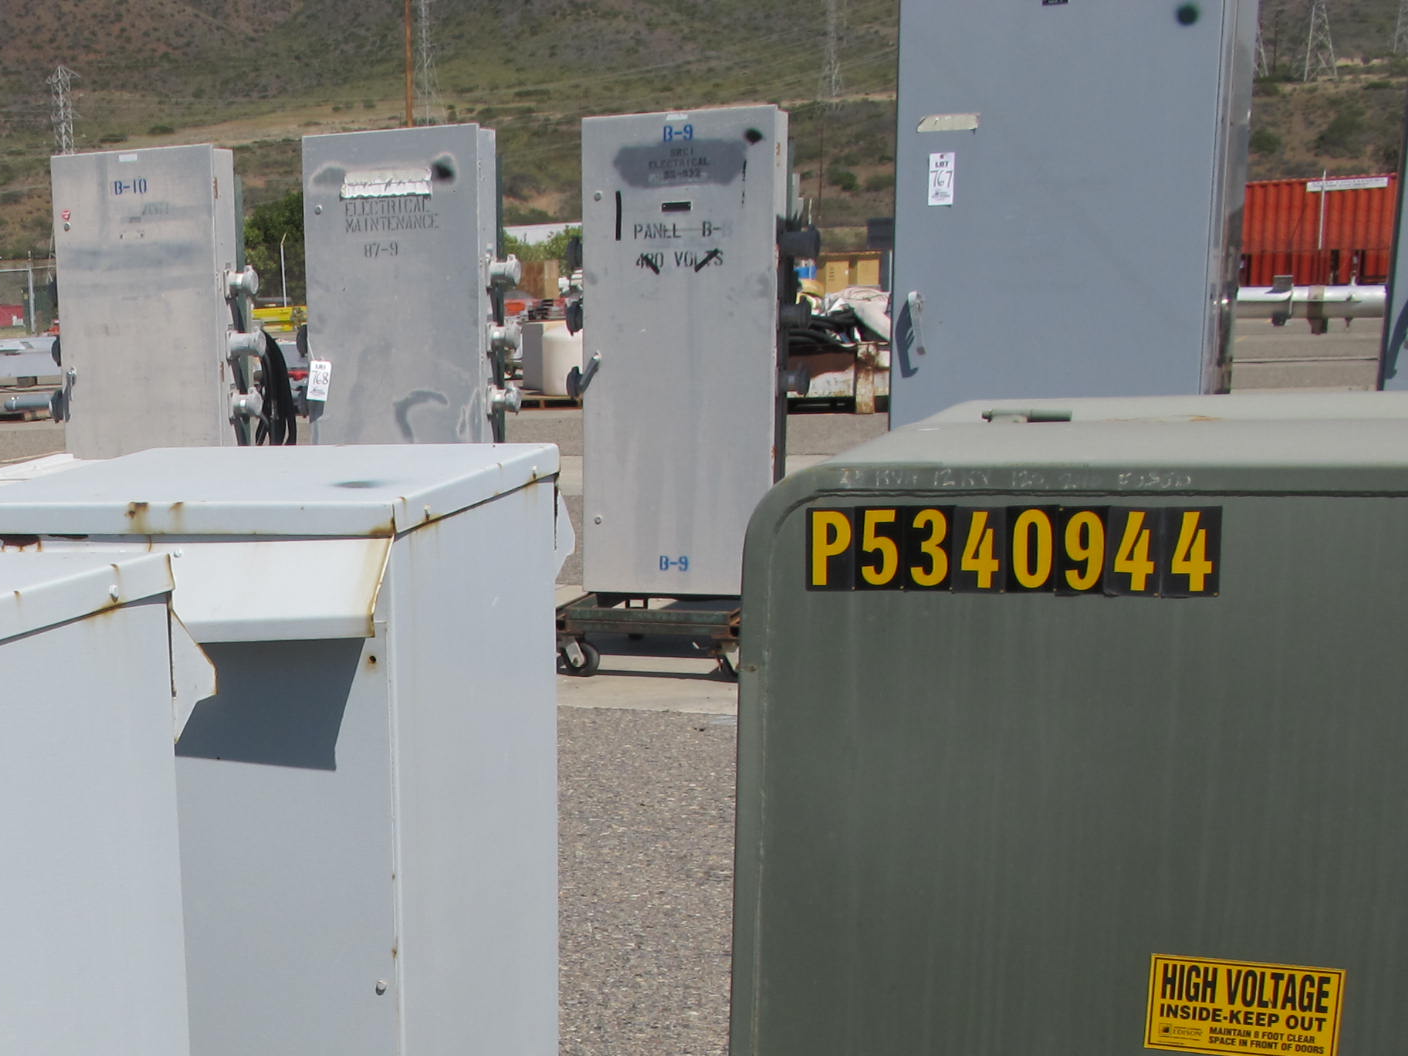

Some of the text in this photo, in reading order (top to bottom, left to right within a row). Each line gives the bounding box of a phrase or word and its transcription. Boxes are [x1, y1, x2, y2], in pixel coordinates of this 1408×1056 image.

[663, 124, 693, 142] B-9
[114, 178, 147, 195] B-10
[930, 169, 952, 188] 767
[345, 197, 431, 216] ELECTRICAL
[345, 213, 440, 232] MAINTENANCE
[634, 223, 682, 240] PANEL
[812, 508, 1213, 593] P5340944
[659, 555, 689, 571] B-9
[1161, 963, 1331, 1014] HIGH VOLTAGE
[1159, 1003, 1328, 1032] INSIDE-KEEP OUT
[1209, 1026, 1252, 1039] MAINTAIN
[1261, 1031, 1284, 1041] FOOT
[1286, 1033, 1315, 1044] CLEAR
[1208, 1036, 1237, 1046] SPACE
[1239, 1038, 1248, 1047] IN
[1250, 1039, 1278, 1050] FRONT
[1281, 1042, 1293, 1051] OF
[1295, 1044, 1325, 1055] DOORS
